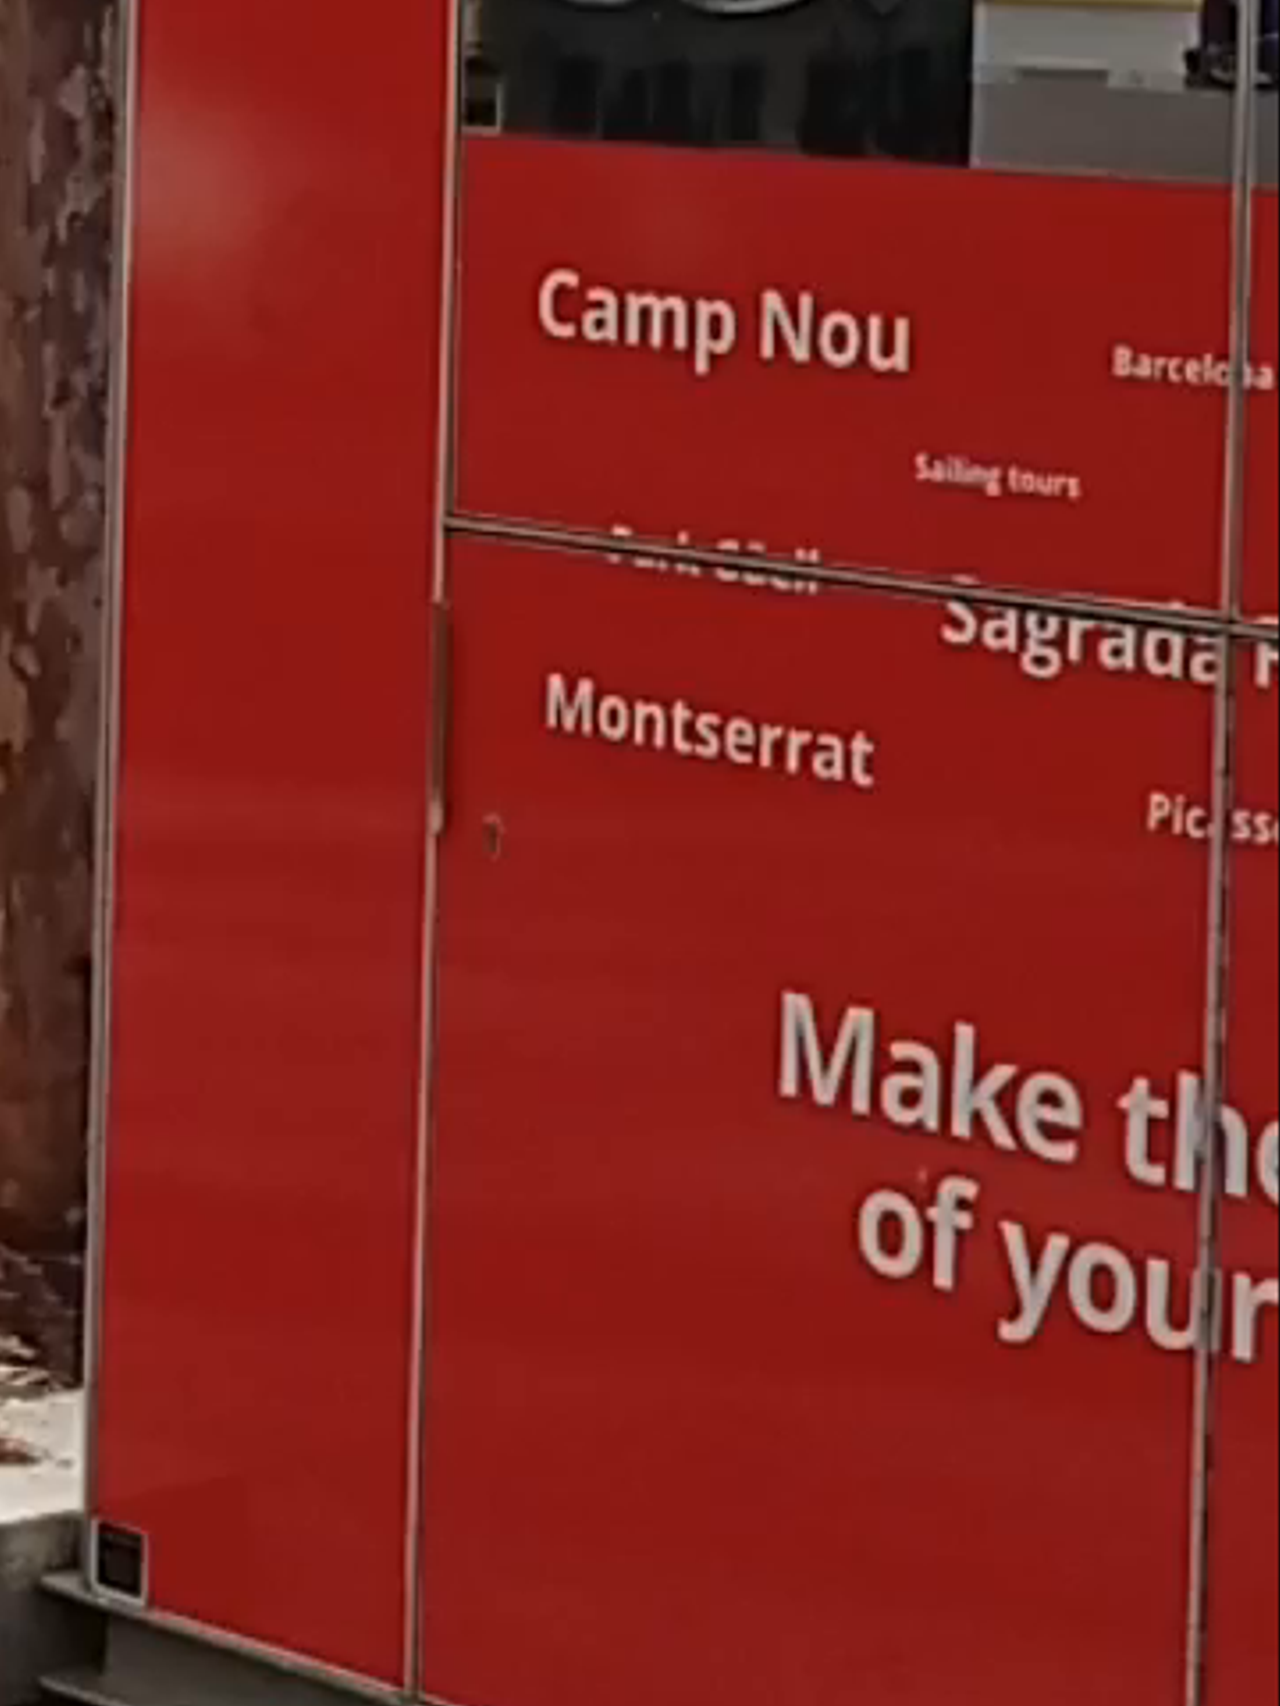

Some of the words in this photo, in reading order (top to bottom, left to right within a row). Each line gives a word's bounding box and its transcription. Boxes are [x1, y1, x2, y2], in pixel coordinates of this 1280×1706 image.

[538, 268, 737, 375] Camp
[759, 289, 911, 372] Nou
[914, 452, 1002, 497] Sailing
[1007, 463, 1082, 501] tours
[545, 671, 875, 787] Montserrat
[1146, 792, 1278, 845] Picss
[777, 989, 1083, 1164] Make
[857, 1174, 981, 1291] of
